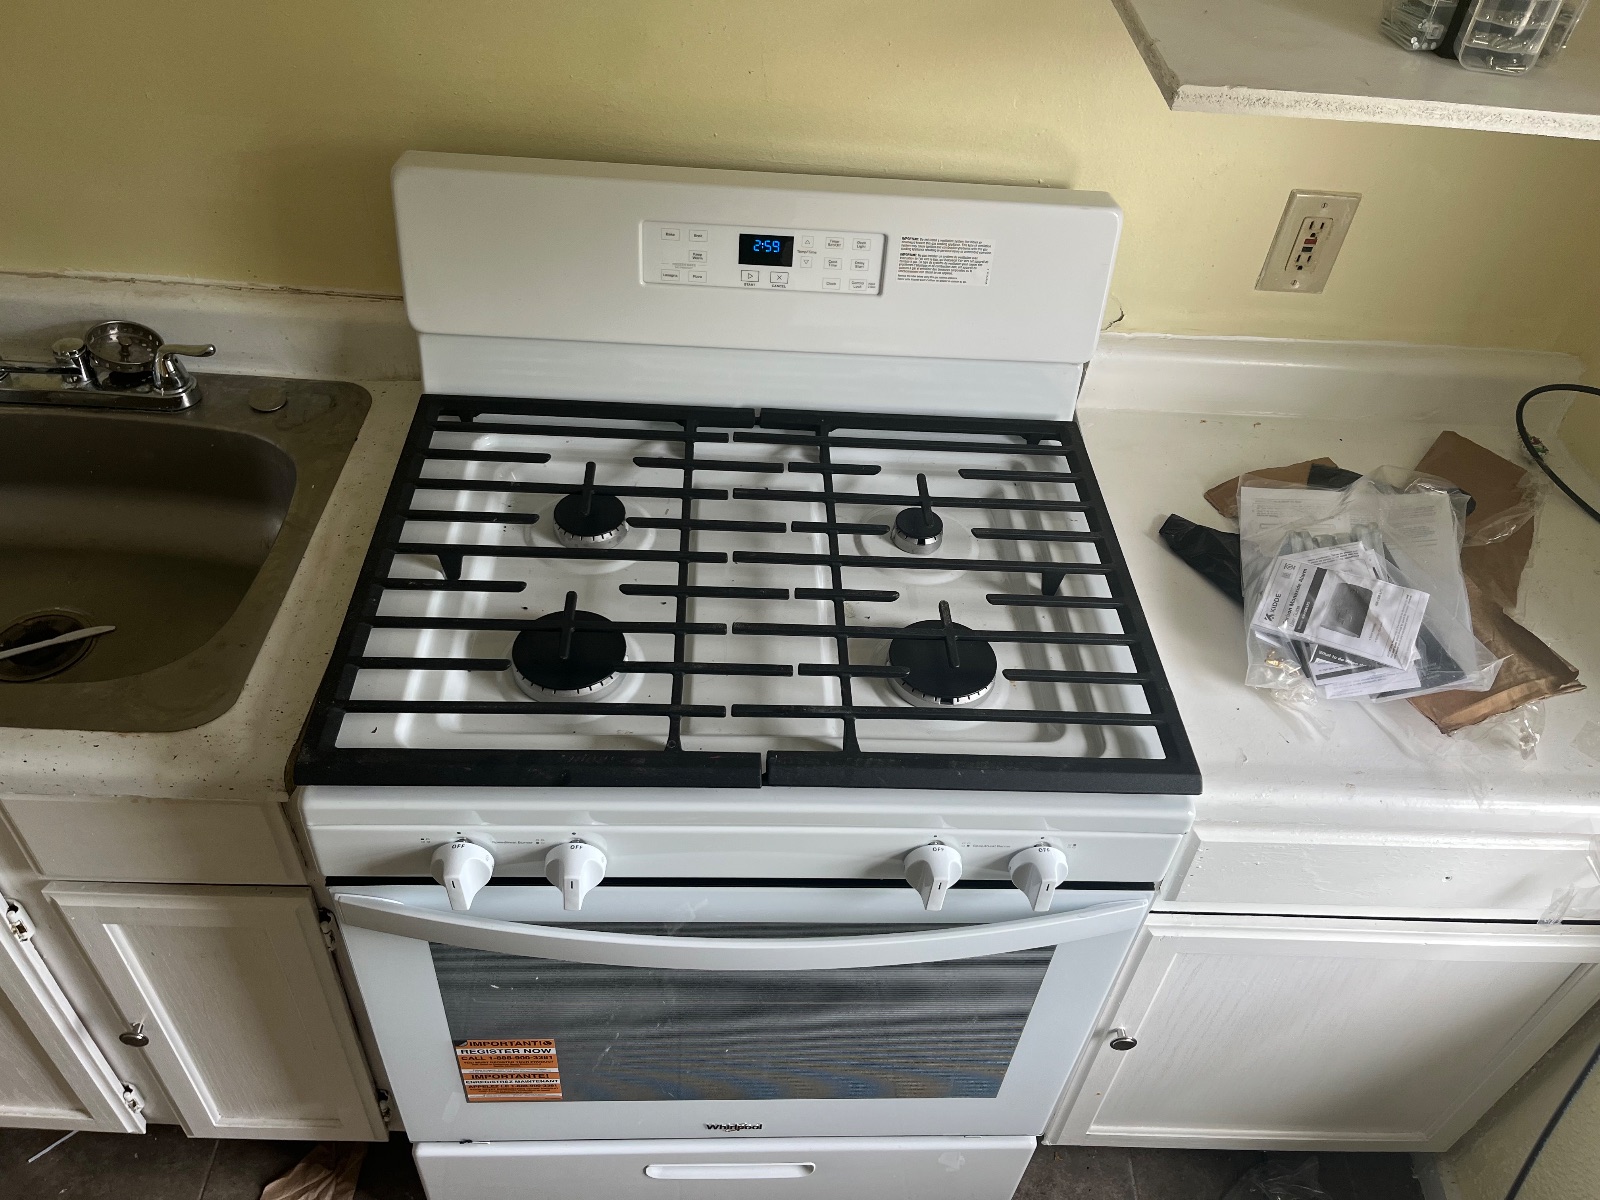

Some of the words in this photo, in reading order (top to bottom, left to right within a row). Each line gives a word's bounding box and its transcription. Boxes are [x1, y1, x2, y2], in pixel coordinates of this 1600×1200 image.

[753, 239, 781, 253] 2:59
[1270, 593, 1282, 613] KIDDE
[705, 1123, 763, 1132] Whirlpool
